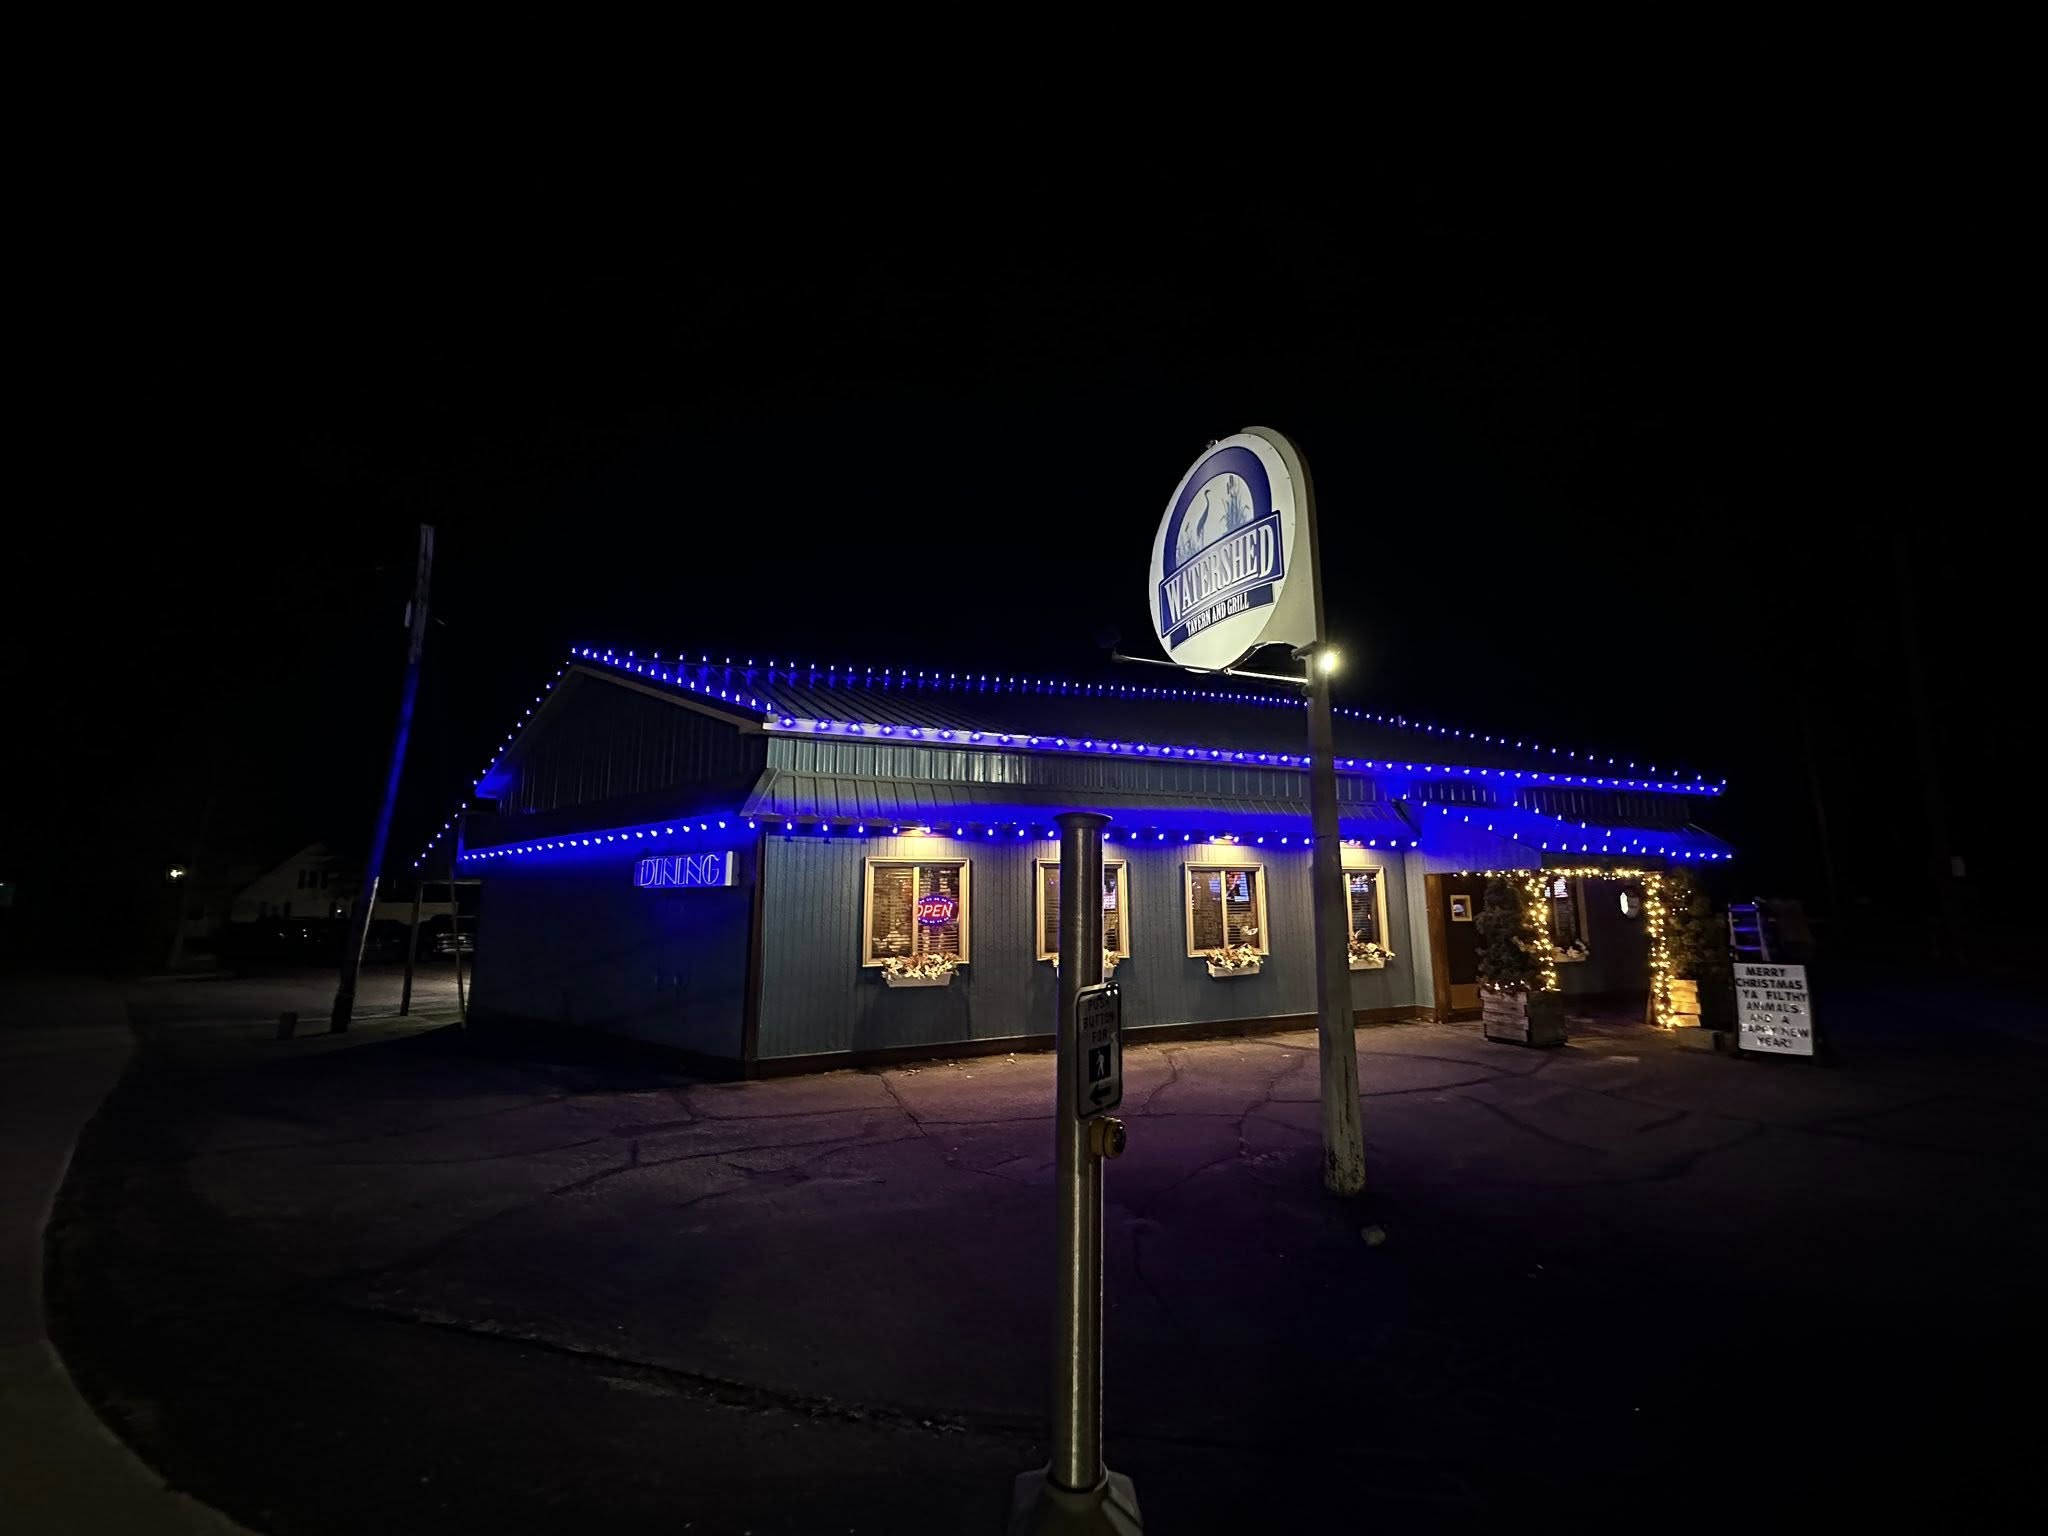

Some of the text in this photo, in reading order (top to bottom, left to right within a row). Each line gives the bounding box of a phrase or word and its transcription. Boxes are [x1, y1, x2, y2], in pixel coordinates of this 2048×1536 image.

[1164, 524, 1275, 624] WATERSHED
[1186, 592, 1250, 637] TAVERN AND GRILL
[640, 854, 720, 886] DINING
[1746, 967, 1785, 977] MERRY
[1736, 978, 1803, 989] CHRISTMAS
[1743, 989, 1807, 1002] YA FILTHY
[1083, 1011, 1115, 1030] BUTTON
[1750, 1013, 1790, 1025] AND A
[1091, 1029, 1108, 1043] FOR
[1781, 1027, 1808, 1038] NEW
